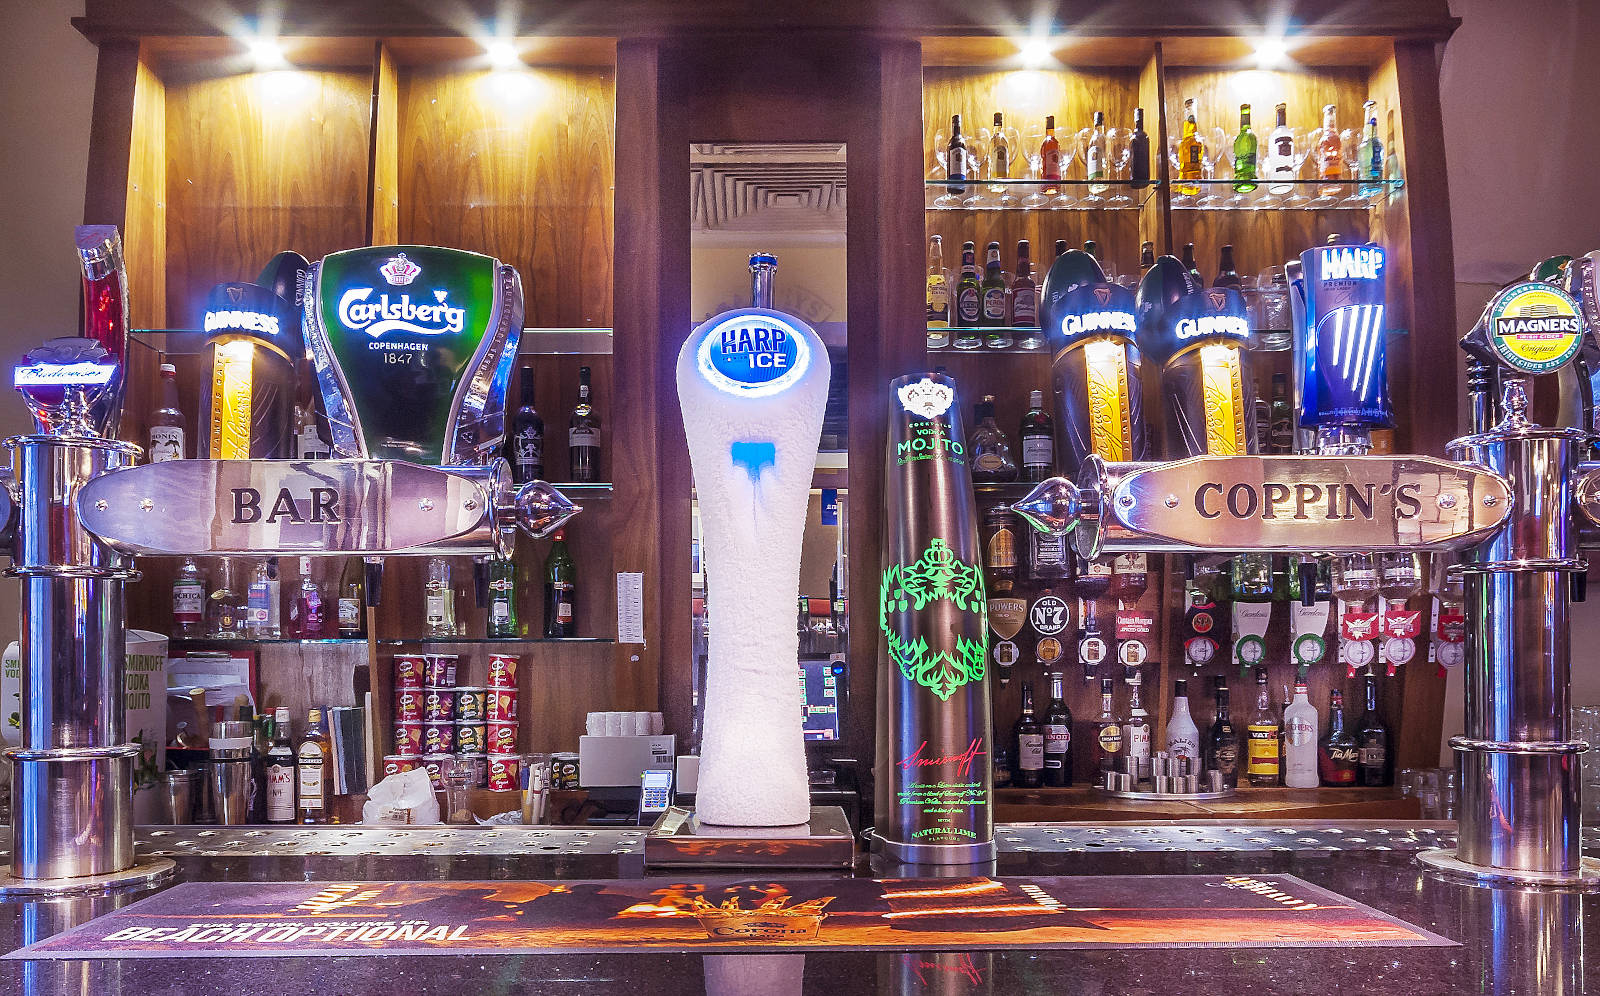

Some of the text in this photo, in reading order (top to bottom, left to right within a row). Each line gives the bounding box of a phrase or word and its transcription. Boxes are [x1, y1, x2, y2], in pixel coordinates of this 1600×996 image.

[1321, 247, 1384, 281] HARP
[338, 287, 465, 335] Carlsberg
[203, 310, 281, 336] GUINNESS
[1498, 318, 1580, 334] MAGNERS
[368, 342, 429, 351] COPENHAGEN
[720, 327, 787, 355] HARP
[1520, 343, 1559, 356] Original
[383, 352, 413, 365] 1847
[748, 352, 788, 369] ICE
[20, 367, 103, 379] Budweiser
[916, 428, 946, 436] VODKA
[897, 437, 964, 456] MOJITO
[230, 487, 342, 525] BAR
[1194, 482, 1422, 521] COPPIN'S
[989, 602, 1024, 613] POWERS
[126, 674, 149, 691] ODKA
[895, 737, 987, 777] Smirnoff
[269, 773, 291, 783] IMM'S
[911, 827, 977, 840] NATURAL LIME
[102, 925, 473, 942] BEACH OPTIONAL
[713, 926, 807, 936] Corona
